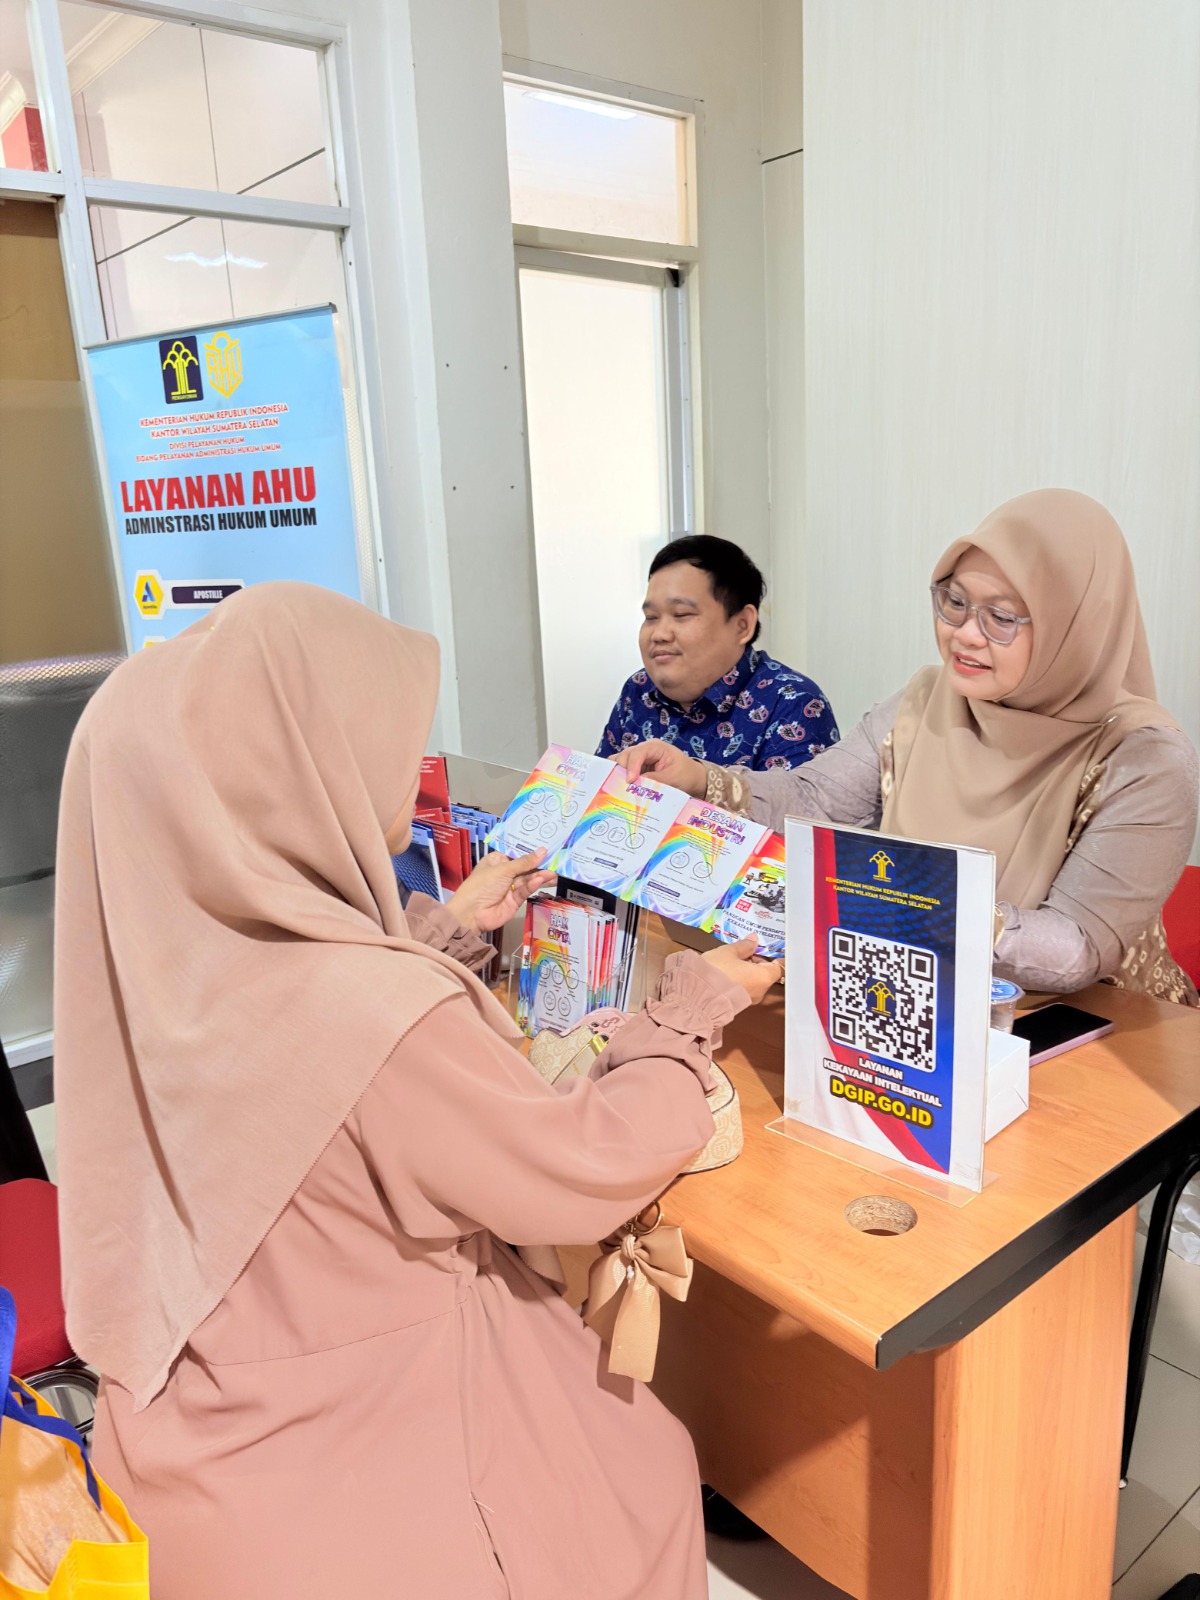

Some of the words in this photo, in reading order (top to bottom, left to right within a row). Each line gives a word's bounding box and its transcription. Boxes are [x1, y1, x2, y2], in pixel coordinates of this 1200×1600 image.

[140, 416, 188, 427] KEMENTERIAN
[189, 413, 215, 422] HUKUM
[216, 409, 248, 419] REPUBLIK
[249, 404, 288, 415] INDONESIA
[151, 428, 180, 438] KANTOR
[181, 425, 211, 436] WILAYAH
[212, 422, 247, 433] SUMATERA
[248, 418, 279, 429] SELATAN
[136, 454, 158, 462] BIDANG
[159, 452, 195, 461] PELAYANAN
[195, 448, 236, 458] ADMINISTRASI
[237, 446, 260, 454] HUKUM
[169, 441, 187, 450] DIVISI
[188, 439, 222, 448] PELAYANAN
[223, 437, 245, 445] HUKUM
[120, 472, 245, 513] LAYANAN
[252, 466, 316, 505] AHU
[125, 514, 215, 535] ADMINSTRASI
[218, 510, 267, 530] HUKUM
[270, 507, 317, 528] UMUM
[193, 589, 223, 599] APOSTILLE
[556, 764, 586, 781] CIPTA
[565, 753, 588, 769] HAK
[626, 783, 664, 802] PATEN
[687, 815, 746, 846] INDUSTRI
[700, 807, 746, 833] DESAIN
[825, 876, 861, 888] KEMENTERIAN
[862, 883, 882, 893] HUKUM
[883, 888, 909, 899] REPUBLIK
[909, 893, 941, 905] INDONESIA
[833, 884, 854, 894] KANTOR
[855, 889, 878, 899] WILAYAH
[879, 893, 907, 905] SUMATERA
[908, 900, 932, 910] SELATAN
[550, 913, 569, 930] HAK
[547, 928, 571, 945] CIPTA
[858, 1057, 903, 1080] LAYANAN
[823, 1058, 873, 1083] KEKAYAAN
[874, 1076, 942, 1107] INTELEKTUAL
[831, 1078, 932, 1126] DGIP.GO.ID
